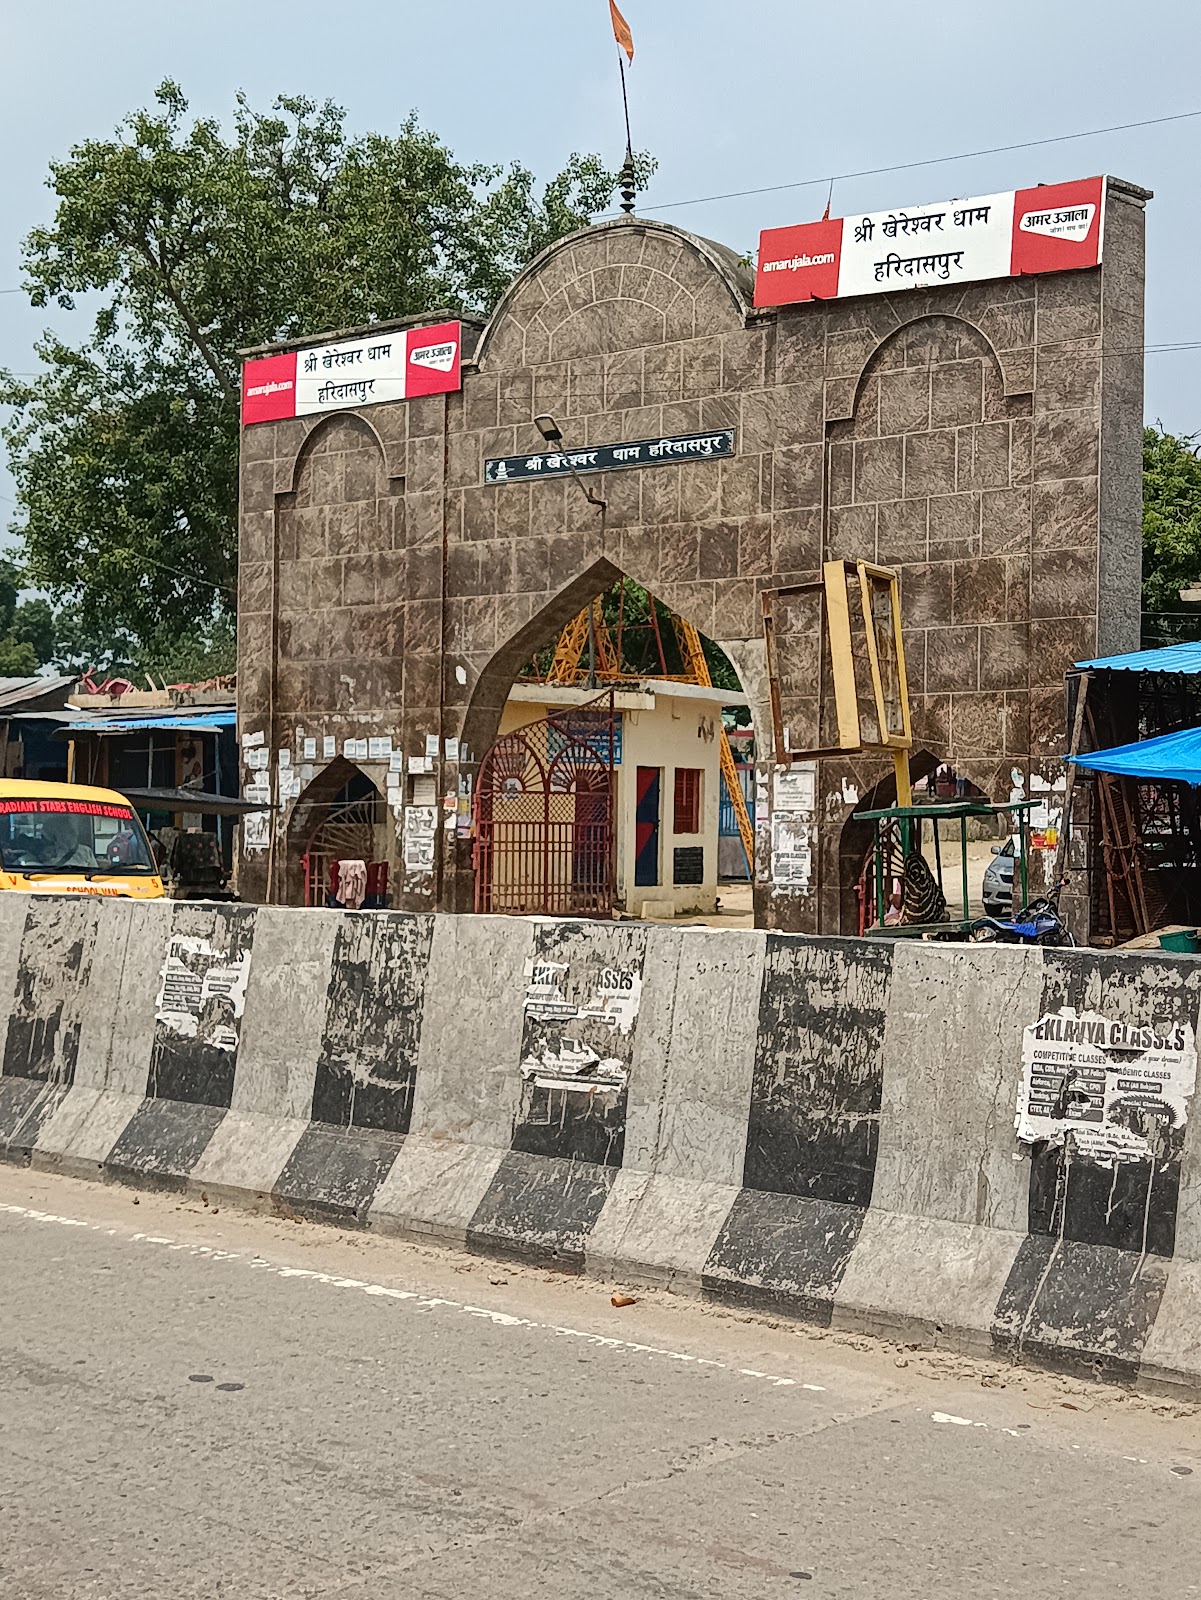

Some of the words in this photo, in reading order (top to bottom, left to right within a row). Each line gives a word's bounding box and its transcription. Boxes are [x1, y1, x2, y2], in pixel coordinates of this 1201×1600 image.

[854, 217, 874, 242] श्री
[882, 211, 947, 239] खेरेश्वर
[953, 205, 991, 226] धाम
[1024, 213, 1052, 228] अमर
[1053, 208, 1089, 224] उजाला
[762, 252, 835, 273] amarujala.com
[874, 250, 965, 283] हरिदासपुर
[304, 353, 318, 372] श्री
[323, 348, 364, 368] खेरेश्वर
[367, 344, 392, 360] धाम
[318, 379, 376, 403] हरिदासपुर
[525, 456, 543, 471] श्री
[613, 446, 641, 461] धाम
[648, 435, 723, 457] हरिदासपुर
[40, 801, 66, 813] STARS
[66, 802, 102, 815] ENGLISH
[103, 806, 133, 820] SCHOOL
[1036, 1018, 1106, 1045] EKLAVYA
[1033, 1050, 1077, 1062] COMPETITIVE
[1078, 1053, 1107, 1065] CLASSES
[1143, 1070, 1171, 1080] CLASSES
